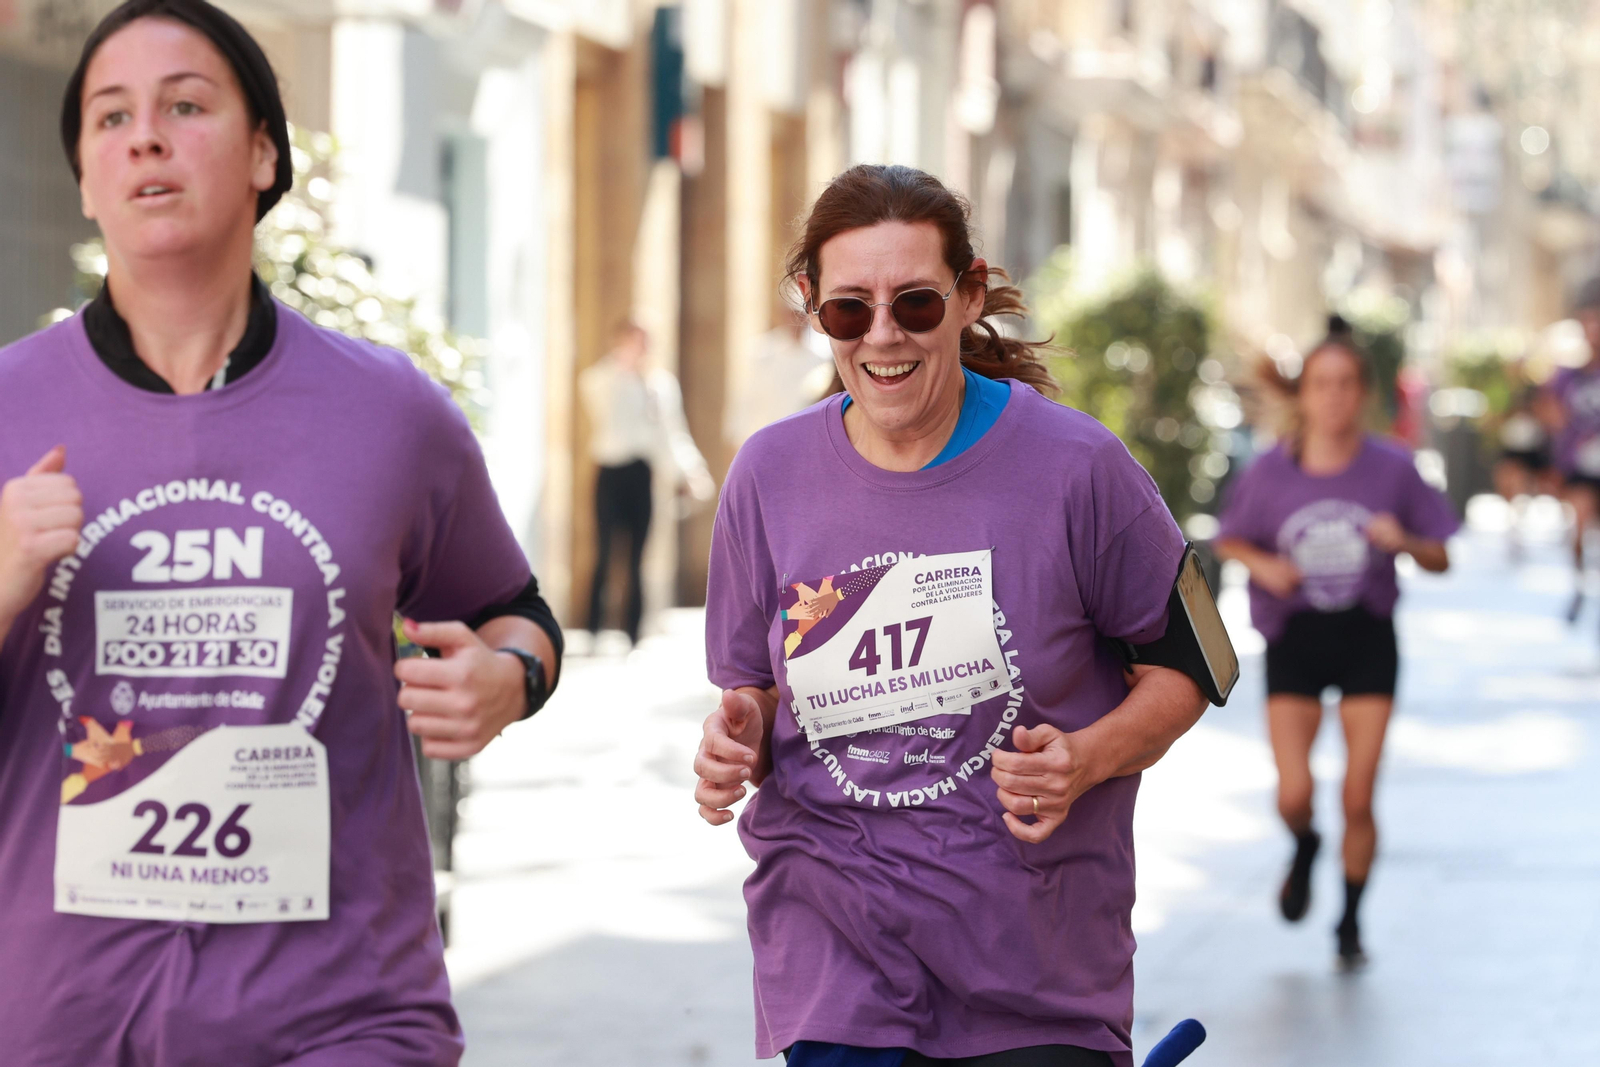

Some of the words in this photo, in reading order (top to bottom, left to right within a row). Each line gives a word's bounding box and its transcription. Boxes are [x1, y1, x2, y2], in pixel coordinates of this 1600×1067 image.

[129, 526, 264, 582] 25N
[38, 606, 64, 657] DÍA
[251, 490, 341, 587] CONTRA
[327, 587, 346, 630] LA
[912, 586, 926, 594] POR
[937, 577, 982, 589] ELIMINACIÓN
[914, 566, 982, 585] CARRERA
[911, 597, 938, 609] CONTRA
[939, 594, 951, 603] LAS
[952, 589, 983, 599] MUJERES
[935, 588, 944, 596] LA
[945, 583, 982, 594] VIOLENCIA
[104, 598, 166, 611] SERVICIO
[169, 597, 185, 609] DE
[189, 595, 282, 609] EMERGENCIAS
[126, 614, 155, 636] 24
[163, 612, 257, 635] HORAS
[104, 641, 166, 668] 900
[169, 641, 199, 668] 21
[202, 641, 231, 668] 21
[235, 640, 276, 668] 30
[849, 615, 933, 676] 417
[1004, 650, 1021, 681] LA
[806, 693, 827, 710] TU
[829, 681, 886, 706] LUCHA
[888, 676, 908, 693] ES
[910, 670, 931, 689] MI
[933, 658, 995, 684] LUCHA
[900, 702, 915, 714] imd
[823, 718, 848, 730] Ayuntamiento
[917, 726, 929, 736] de
[930, 727, 956, 740] Cádiz
[956, 686, 1025, 782] VIOLENCIA
[235, 745, 315, 763] CARRERA
[903, 748, 929, 766] imd
[842, 779, 881, 807] LAS
[886, 776, 957, 807] HACIA
[129, 800, 252, 858] 226
[111, 861, 133, 879] NI
[138, 864, 184, 882] UNA
[190, 866, 269, 885] MENOS
